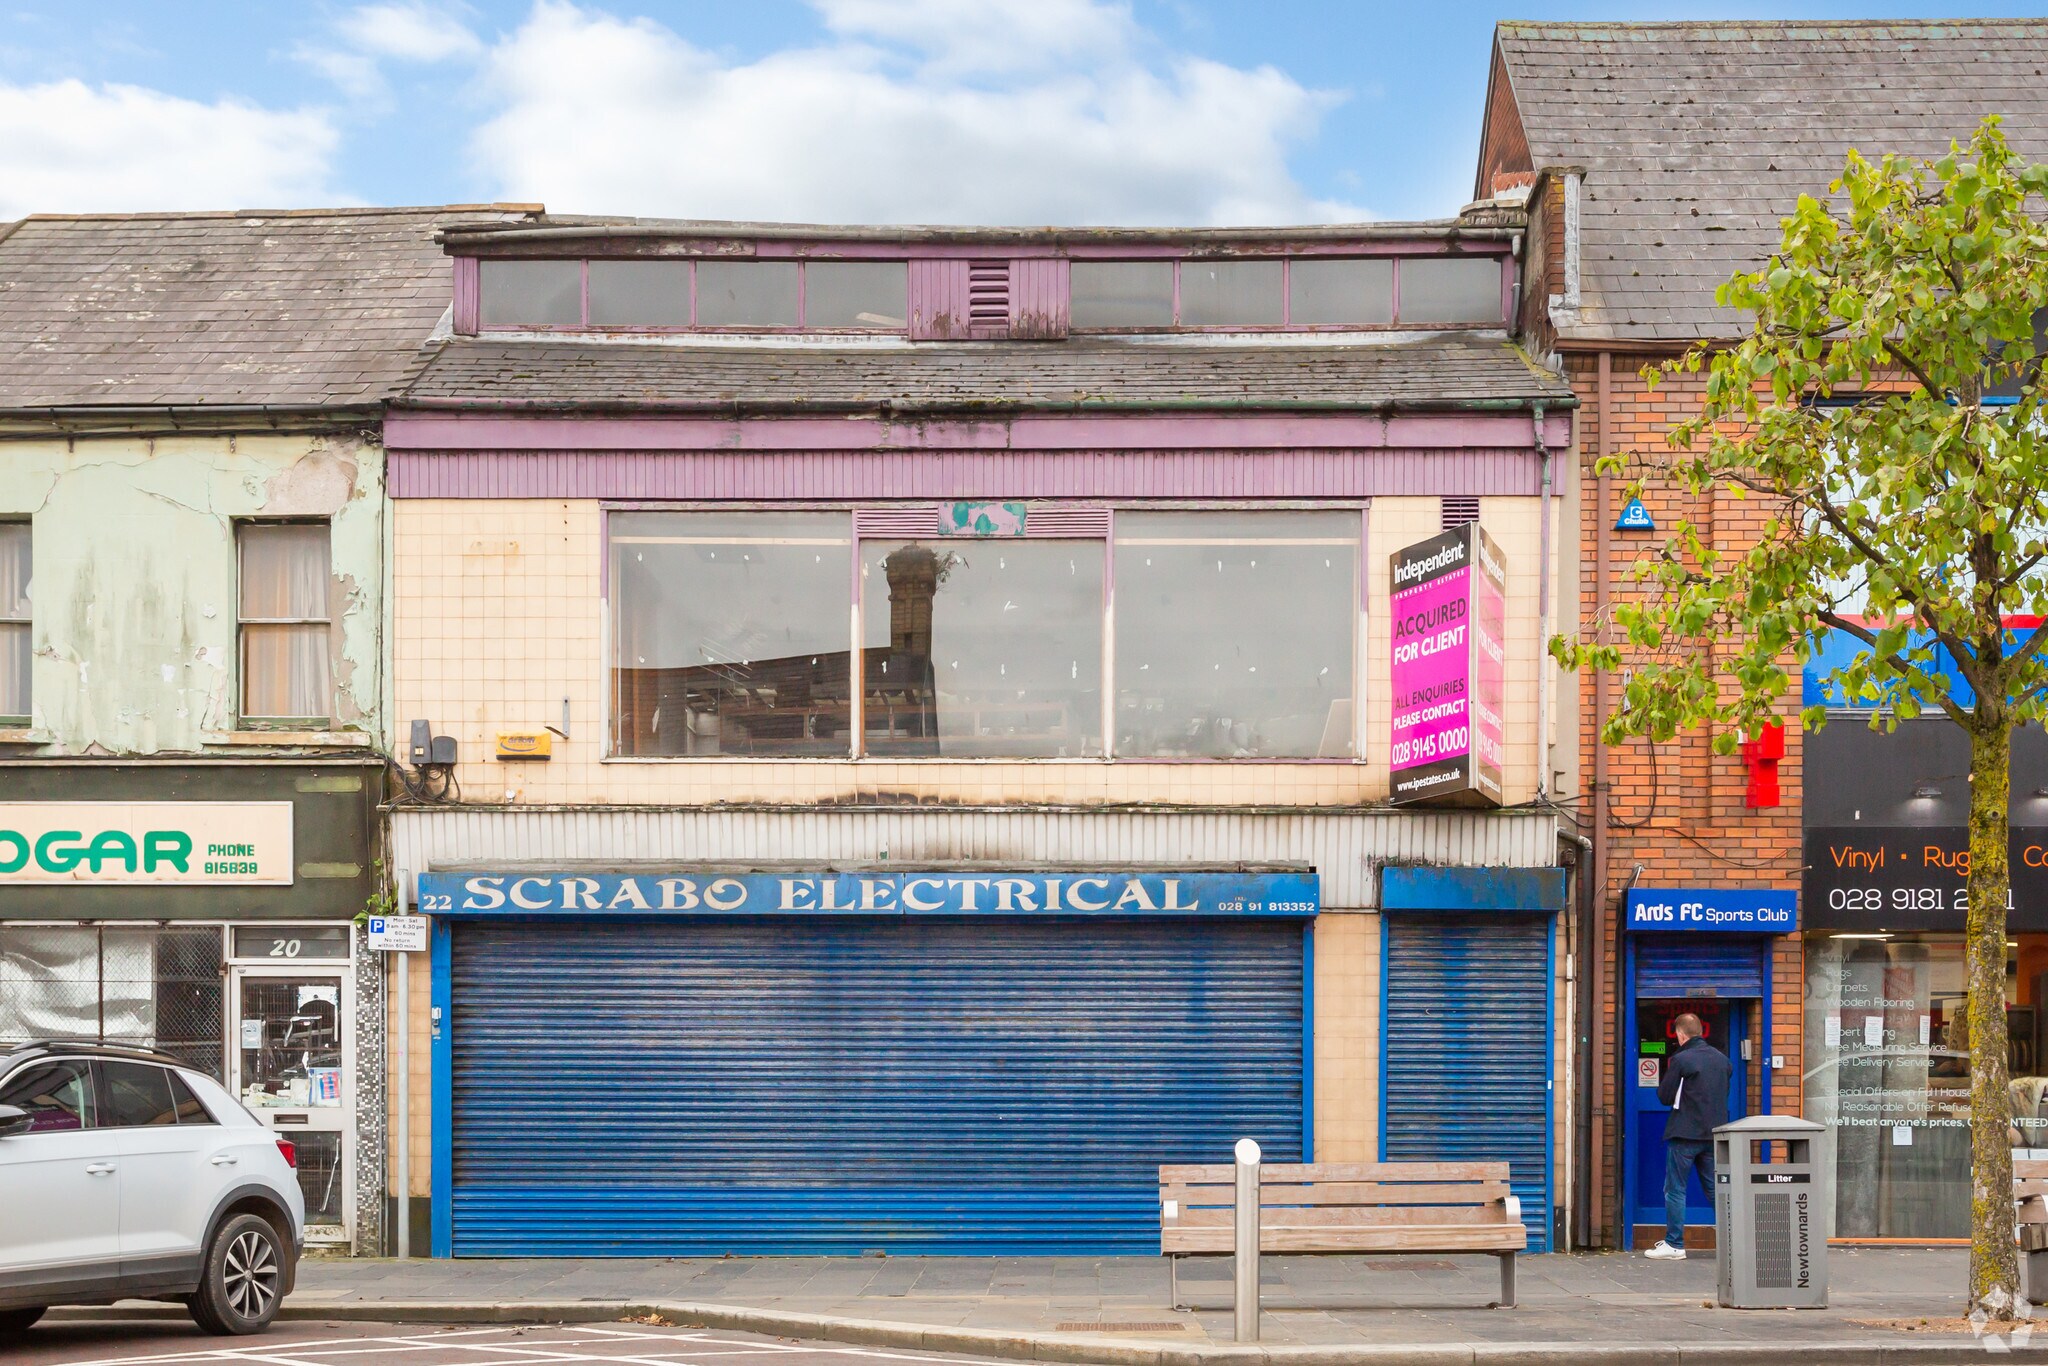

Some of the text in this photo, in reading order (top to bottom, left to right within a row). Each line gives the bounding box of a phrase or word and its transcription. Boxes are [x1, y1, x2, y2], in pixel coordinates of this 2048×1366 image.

[1394, 541, 1464, 585] Independent
[1395, 582, 1432, 600] PROPERTY
[1437, 569, 1465, 585] ESTATES
[1395, 597, 1466, 640] ACQUIRED
[1394, 624, 1466, 666] FOR CLIENT
[1395, 678, 1465, 711] ALL ENQUIRIES
[1393, 698, 1466, 731] PLEASE CONTACT
[1392, 740, 1411, 765] 028
[1412, 734, 1436, 760] 9145
[1438, 726, 1468, 754] 0000
[1397, 767, 1460, 791] www.ipestates.co.uk
[208, 843, 255, 856] PHONE
[1830, 846, 1884, 873] Vinyl
[1924, 846, 1971, 877] Rug
[423, 877, 1199, 911] 22 SCRABO ELECTRICAL
[1829, 888, 1882, 910] 028
[1892, 888, 1944, 910] 9181
[1218, 902, 1315, 911] 028 91 813352
[1635, 903, 1789, 924] Ards FC Sports Club
[373, 920, 383, 933] P
[270, 939, 301, 958] 20
[1826, 967, 1852, 981] Rugs
[1826, 982, 1868, 994] Carpets
[1826, 997, 1915, 1011] Wooden Flooring
[1852, 1042, 1905, 1054] Measuring
[1908, 1042, 1947, 1052] Service
[1852, 1057, 1893, 1068] Delivery
[1896, 1057, 1935, 1067] Service
[1825, 1087, 1861, 1099] Special
[1865, 1087, 1898, 1097] Offers
[1940, 1087, 1971, 1097] House
[1825, 1101, 1972, 1112] No Reasonable Offer Refuse
[1825, 1116, 1849, 1126] We'll
[1851, 1116, 1878, 1126] beat
[1880, 1116, 1928, 1129] anyone's
[1929, 1116, 1964, 1128] prices,
[1767, 1174, 1793, 1183] Litter
[1796, 1192, 1810, 1288] Newtownards
